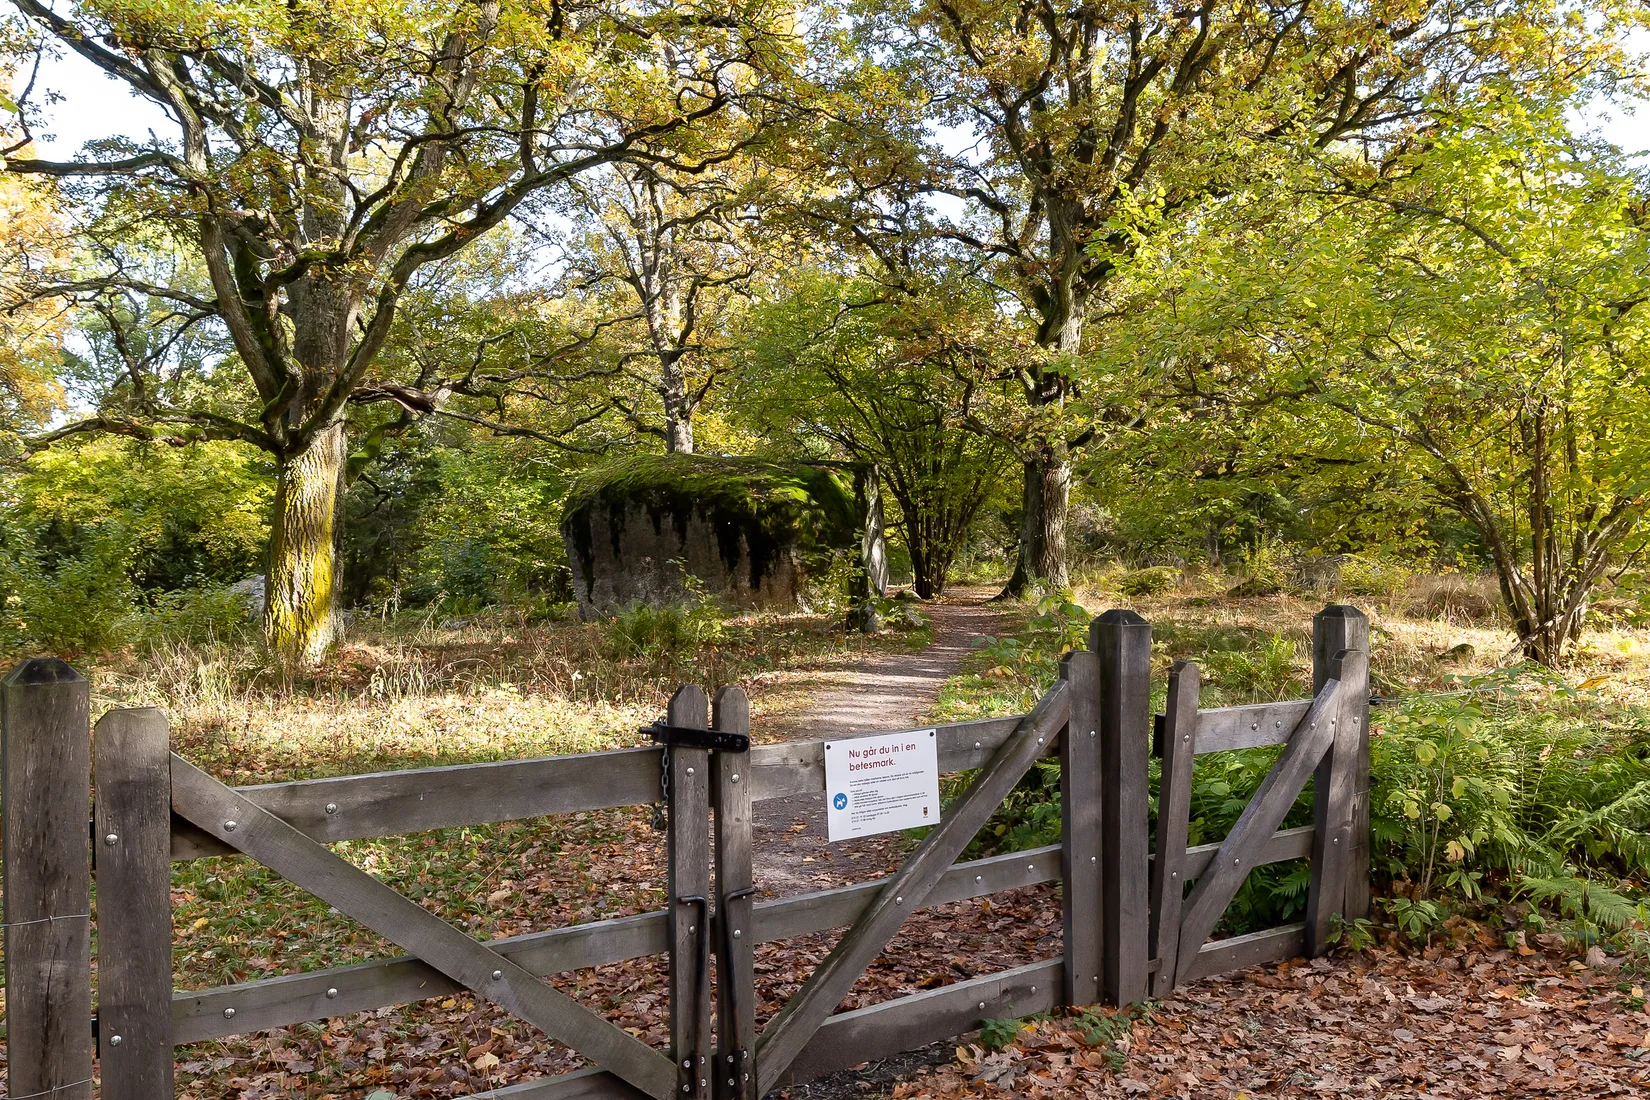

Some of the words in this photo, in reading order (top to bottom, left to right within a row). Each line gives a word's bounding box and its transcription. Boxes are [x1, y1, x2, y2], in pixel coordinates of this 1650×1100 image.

[849, 749, 860, 758] Nu
[862, 746, 877, 758] går
[879, 746, 889, 754] du
[891, 744, 899, 752] in
[905, 743, 916, 751] en
[849, 758, 896, 771] betesmark.
